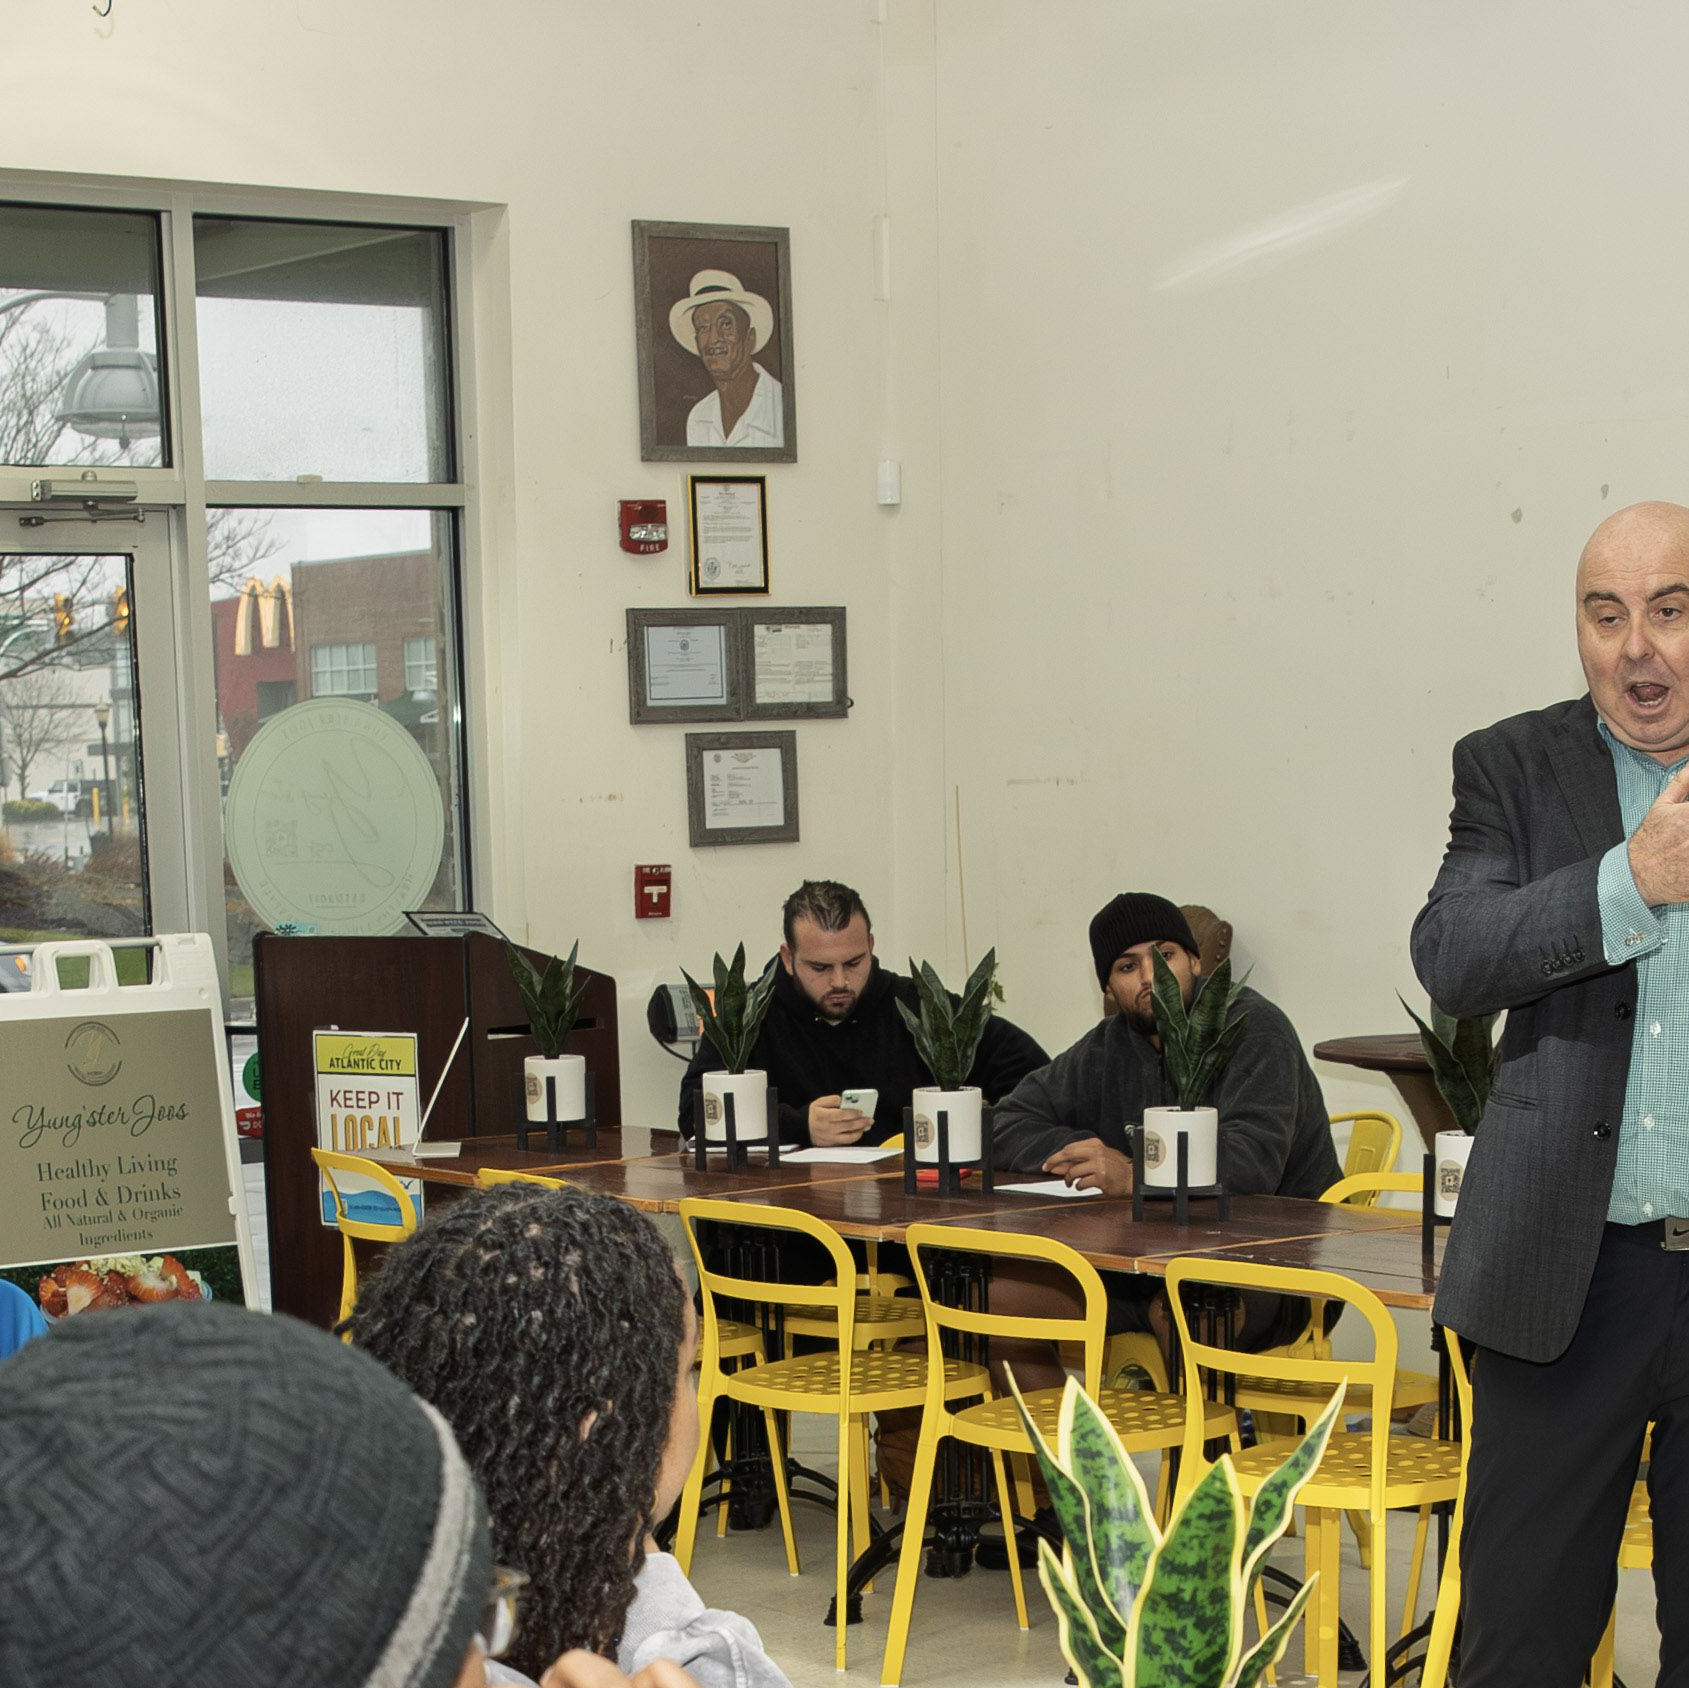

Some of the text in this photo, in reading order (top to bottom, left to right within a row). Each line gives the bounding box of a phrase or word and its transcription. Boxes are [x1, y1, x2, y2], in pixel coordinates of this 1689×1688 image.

[640, 544, 660, 552] FIRE
[329, 1057, 402, 1071] ATLANTIC CITY
[329, 1089, 404, 1111] KEEP IT
[37, 1153, 178, 1183] Healthy Living
[40, 1182, 182, 1211] Food & Drinks
[43, 1204, 184, 1230] All Natural & Organic
[79, 1227, 154, 1249] Ingredients
